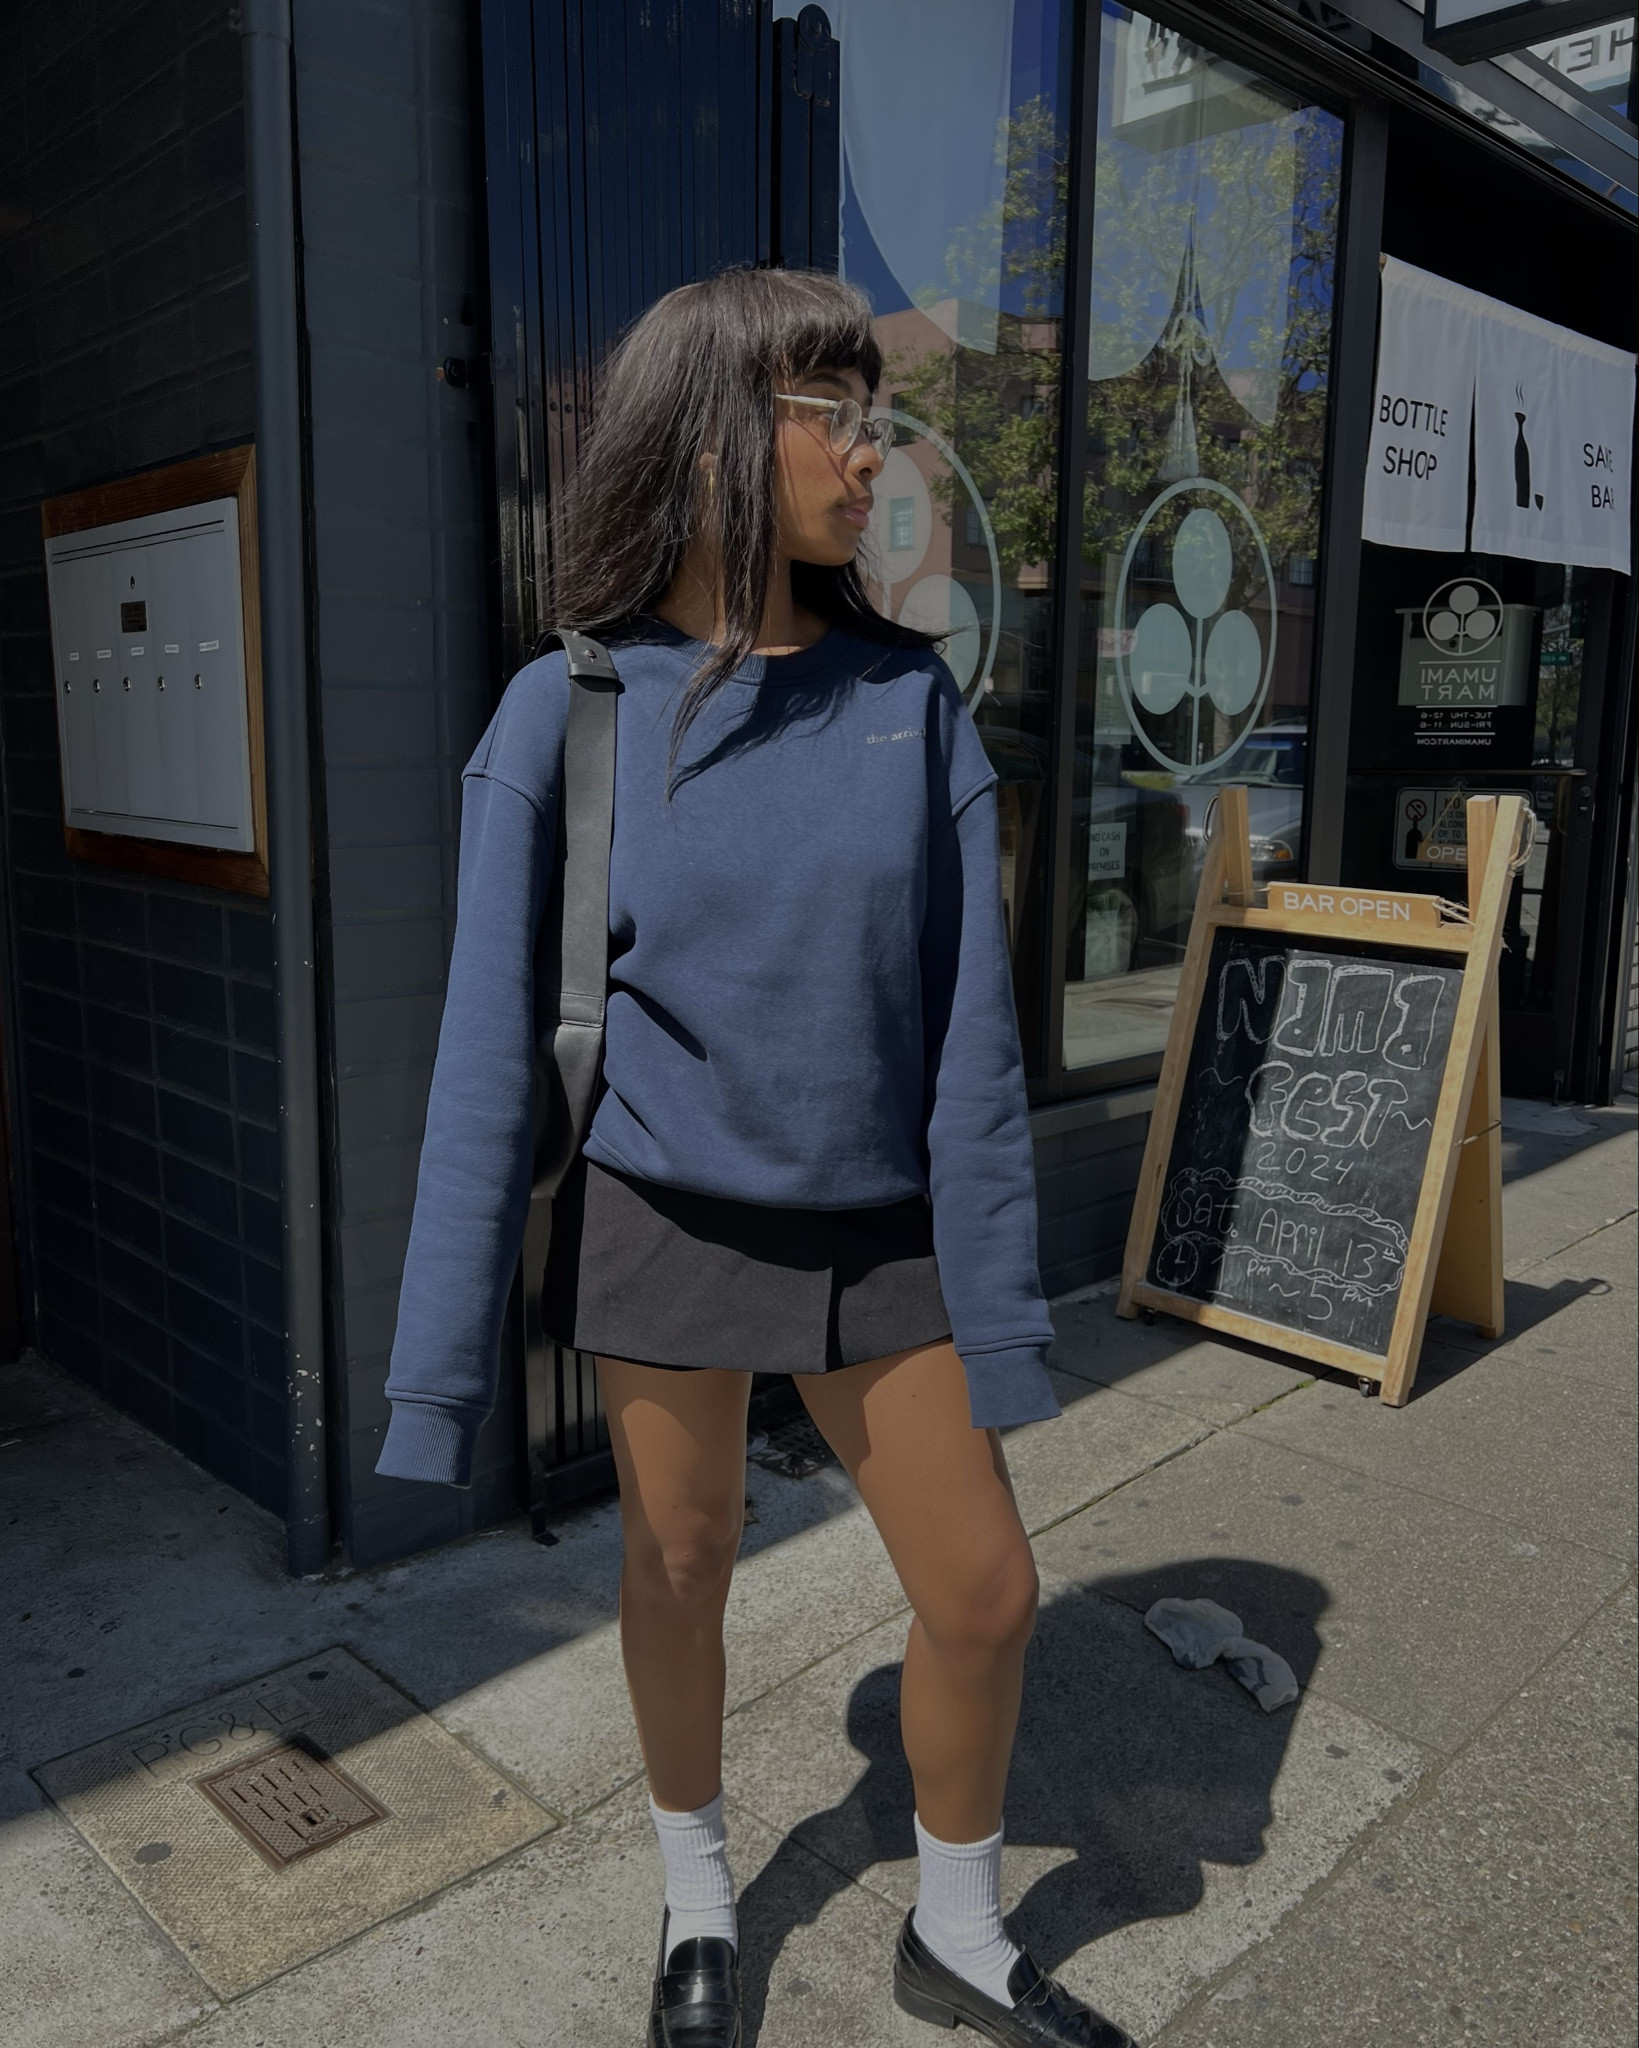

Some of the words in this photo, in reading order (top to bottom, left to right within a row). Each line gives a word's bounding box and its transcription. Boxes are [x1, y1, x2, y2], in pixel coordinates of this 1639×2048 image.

[1379, 394, 1449, 437] BOTTLE
[1382, 446, 1438, 480] SHOP
[1583, 443, 1613, 473] SAE
[866, 734, 888, 745] the
[1102, 831, 1121, 842] CASH
[1099, 847, 1110, 857] ON
[1426, 845, 1466, 862] OPE
[1283, 891, 1335, 914] BAR
[1340, 896, 1410, 922] OPEN
[1255, 1141, 1355, 1186] 2024
[1255, 1207, 1326, 1267] April
